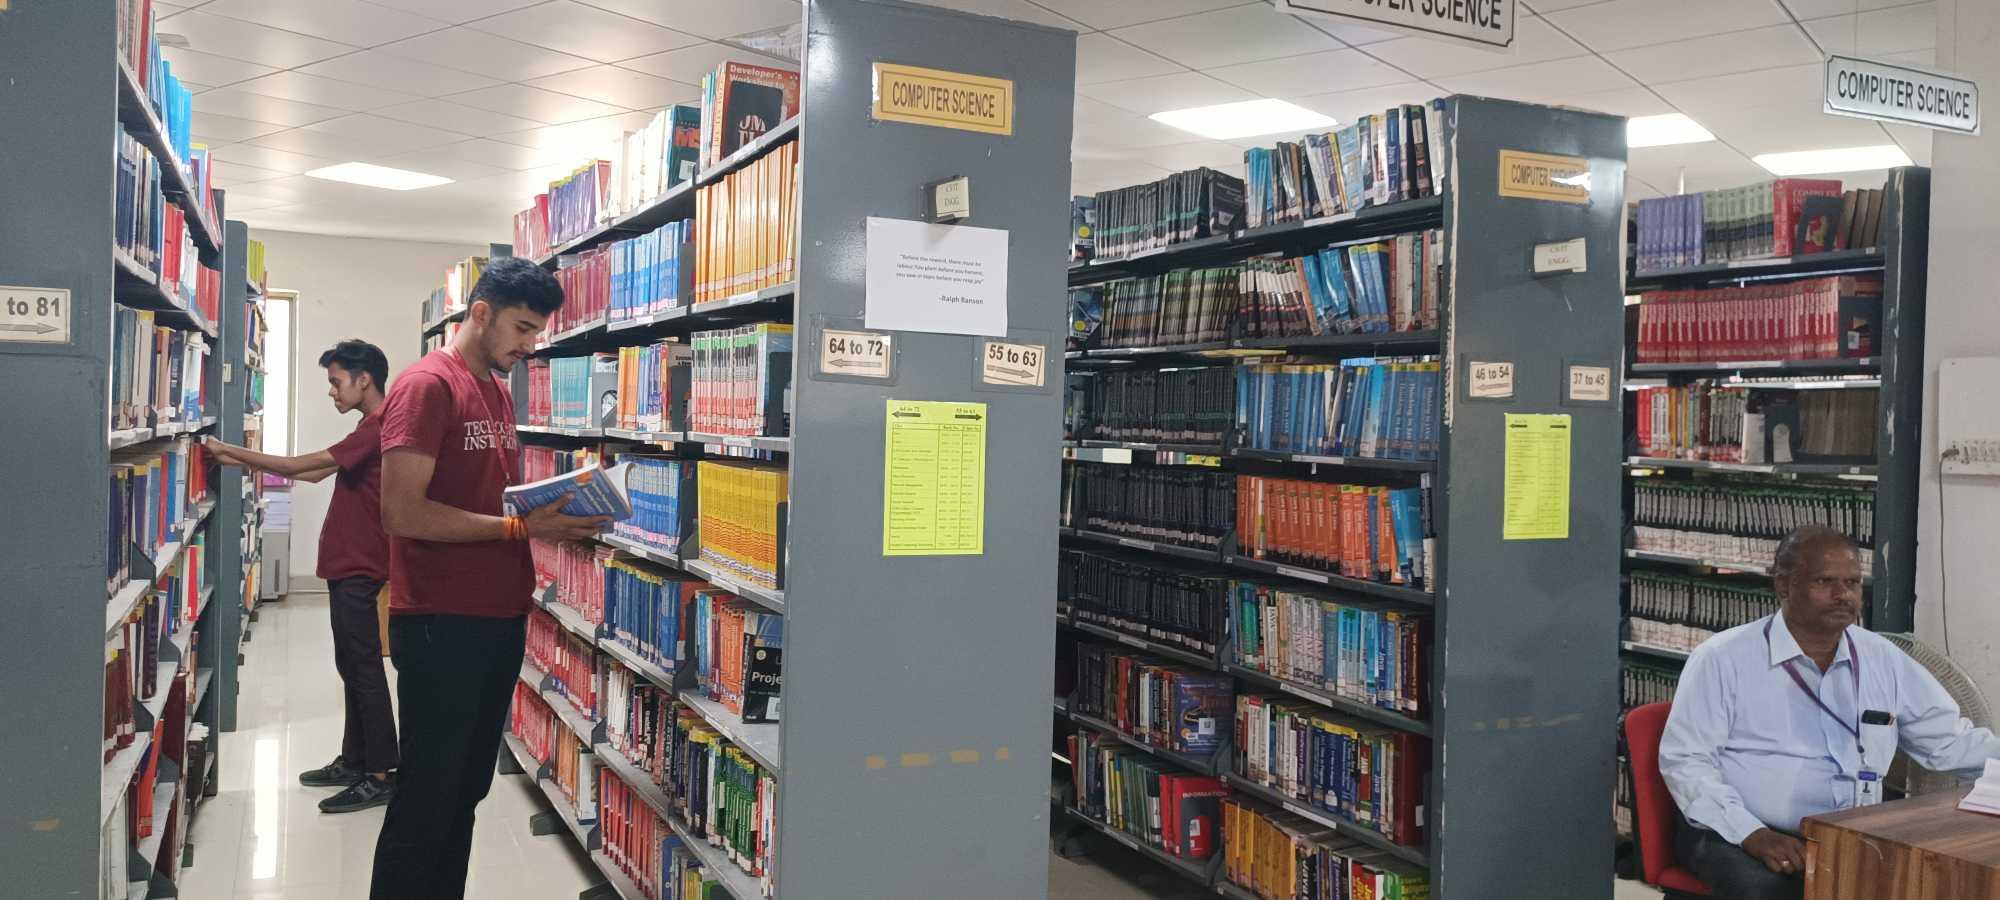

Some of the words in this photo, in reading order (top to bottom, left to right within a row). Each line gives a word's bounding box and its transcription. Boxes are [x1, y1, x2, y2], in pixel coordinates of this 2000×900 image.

[729, 64, 783, 80] Developer's
[892, 80, 950, 112] COMPUTER
[952, 89, 995, 118] SCIENCE
[1837, 69, 1914, 110] COMPUTER
[1917, 83, 1970, 119] SCIENCE
[1511, 164, 1549, 187] COMPUTER
[7, 296, 29, 316] to
[36, 296, 60, 317] 81
[829, 337, 846, 355] 64
[850, 338, 863, 355] to
[867, 339, 883, 357] 72
[988, 344, 1004, 360] 55
[1007, 347, 1019, 364] to
[1022, 350, 1037, 367] 63
[1475, 368, 1485, 381] 46
[1488, 367, 1497, 380] to
[1499, 366, 1510, 379] 54
[1573, 372, 1583, 385] 37
[1585, 374, 1594, 385] to
[1595, 373, 1605, 385] 45
[1378, 651, 1387, 670] Java
[1361, 757, 1369, 774] JAVA
[1374, 774, 1382, 793] Java
[1302, 860, 1311, 893] Java
